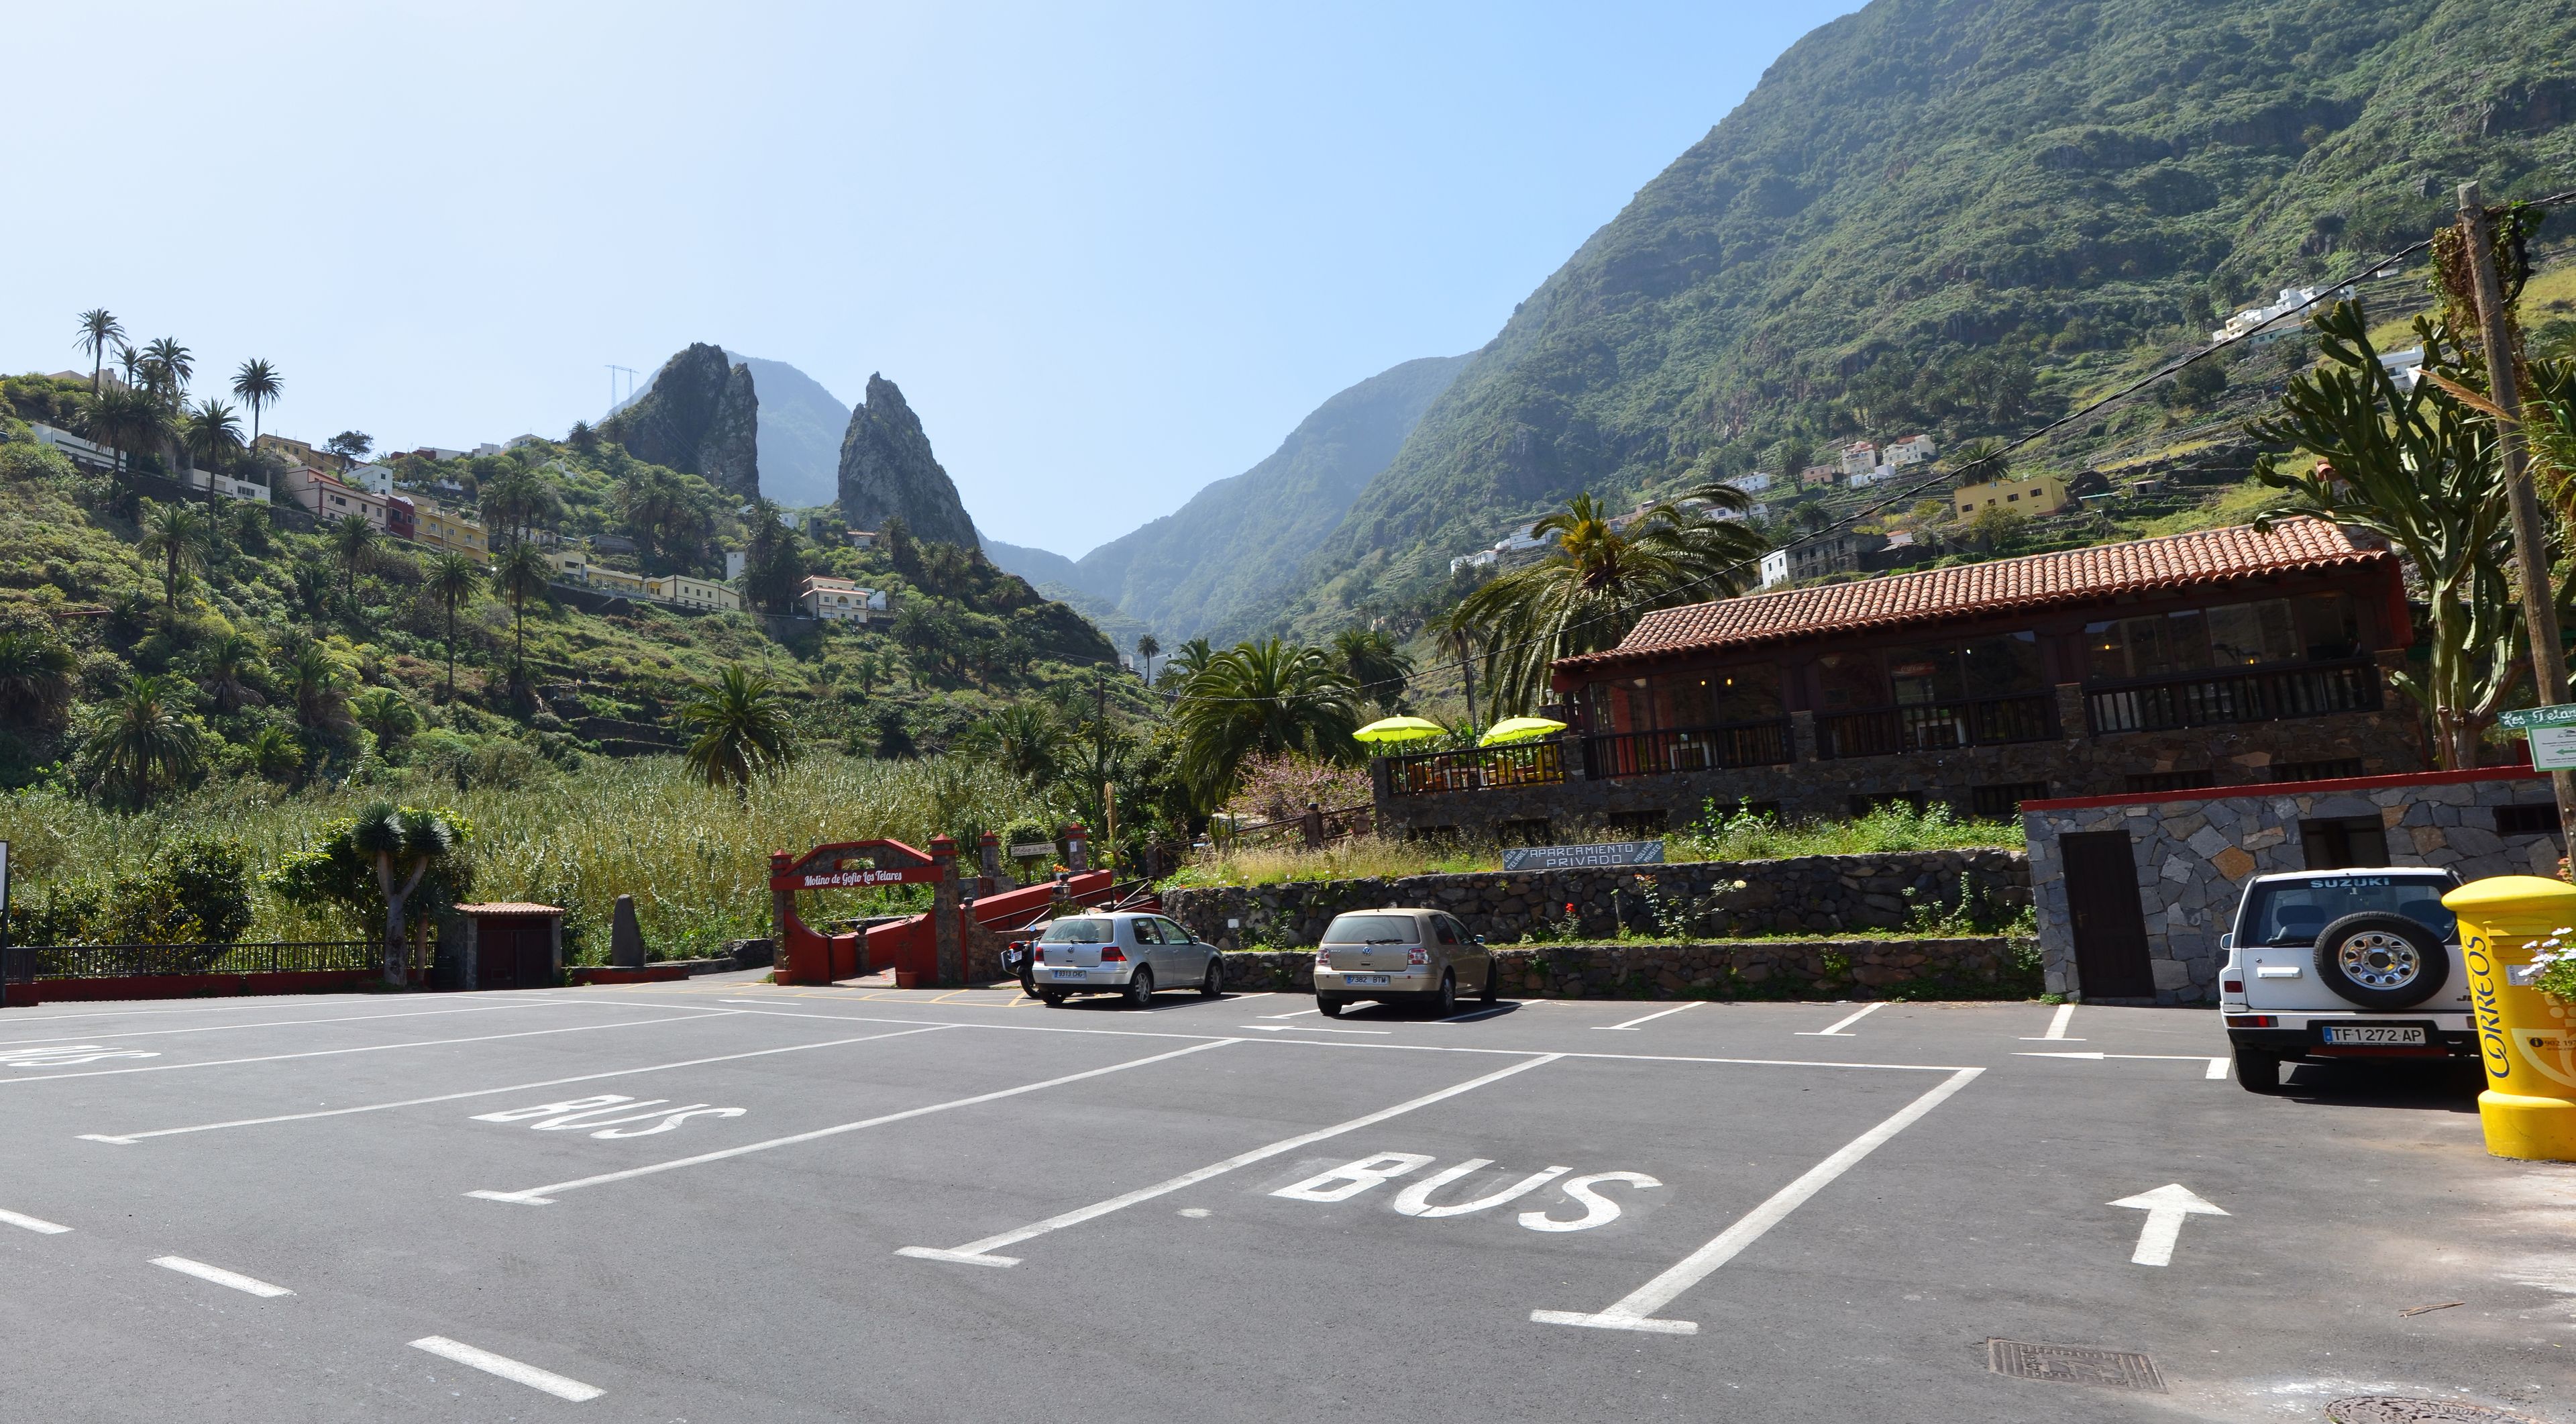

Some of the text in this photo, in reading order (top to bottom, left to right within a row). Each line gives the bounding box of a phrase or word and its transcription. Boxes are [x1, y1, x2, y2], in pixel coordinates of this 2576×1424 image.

[1504, 850, 1516, 863] LOS
[1507, 848, 1529, 870] TELARES
[1529, 844, 1633, 858] APARCAMIENTO
[1633, 842, 1654, 864] MOLINO
[1644, 844, 1662, 863] MUSEO
[1546, 855, 1622, 867] PRIVADO
[805, 870, 902, 886] Molino de Gofio Los Telares
[2311, 878, 2390, 888] SUZUKI
[2464, 935, 2510, 1078] CORREOS
[468, 1095, 747, 1139] BUS
[1267, 1152, 1663, 1232] BUS
